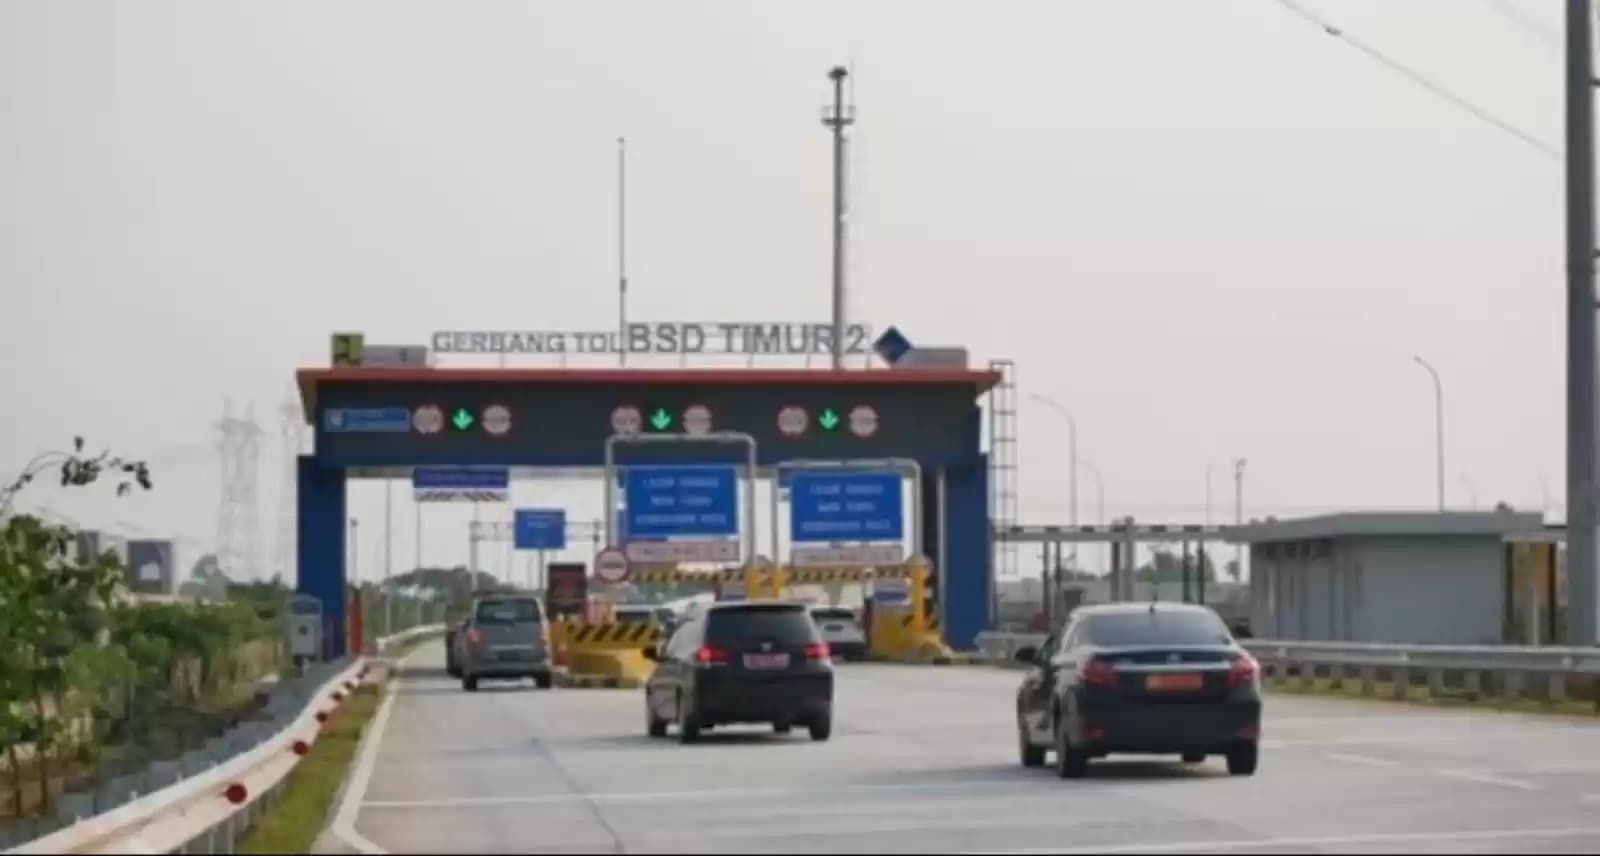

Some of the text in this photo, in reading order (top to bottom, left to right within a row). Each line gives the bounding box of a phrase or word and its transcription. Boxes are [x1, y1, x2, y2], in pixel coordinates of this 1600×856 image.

[432, 323, 866, 353] GERBANG TOL BSD TIMUR 2
